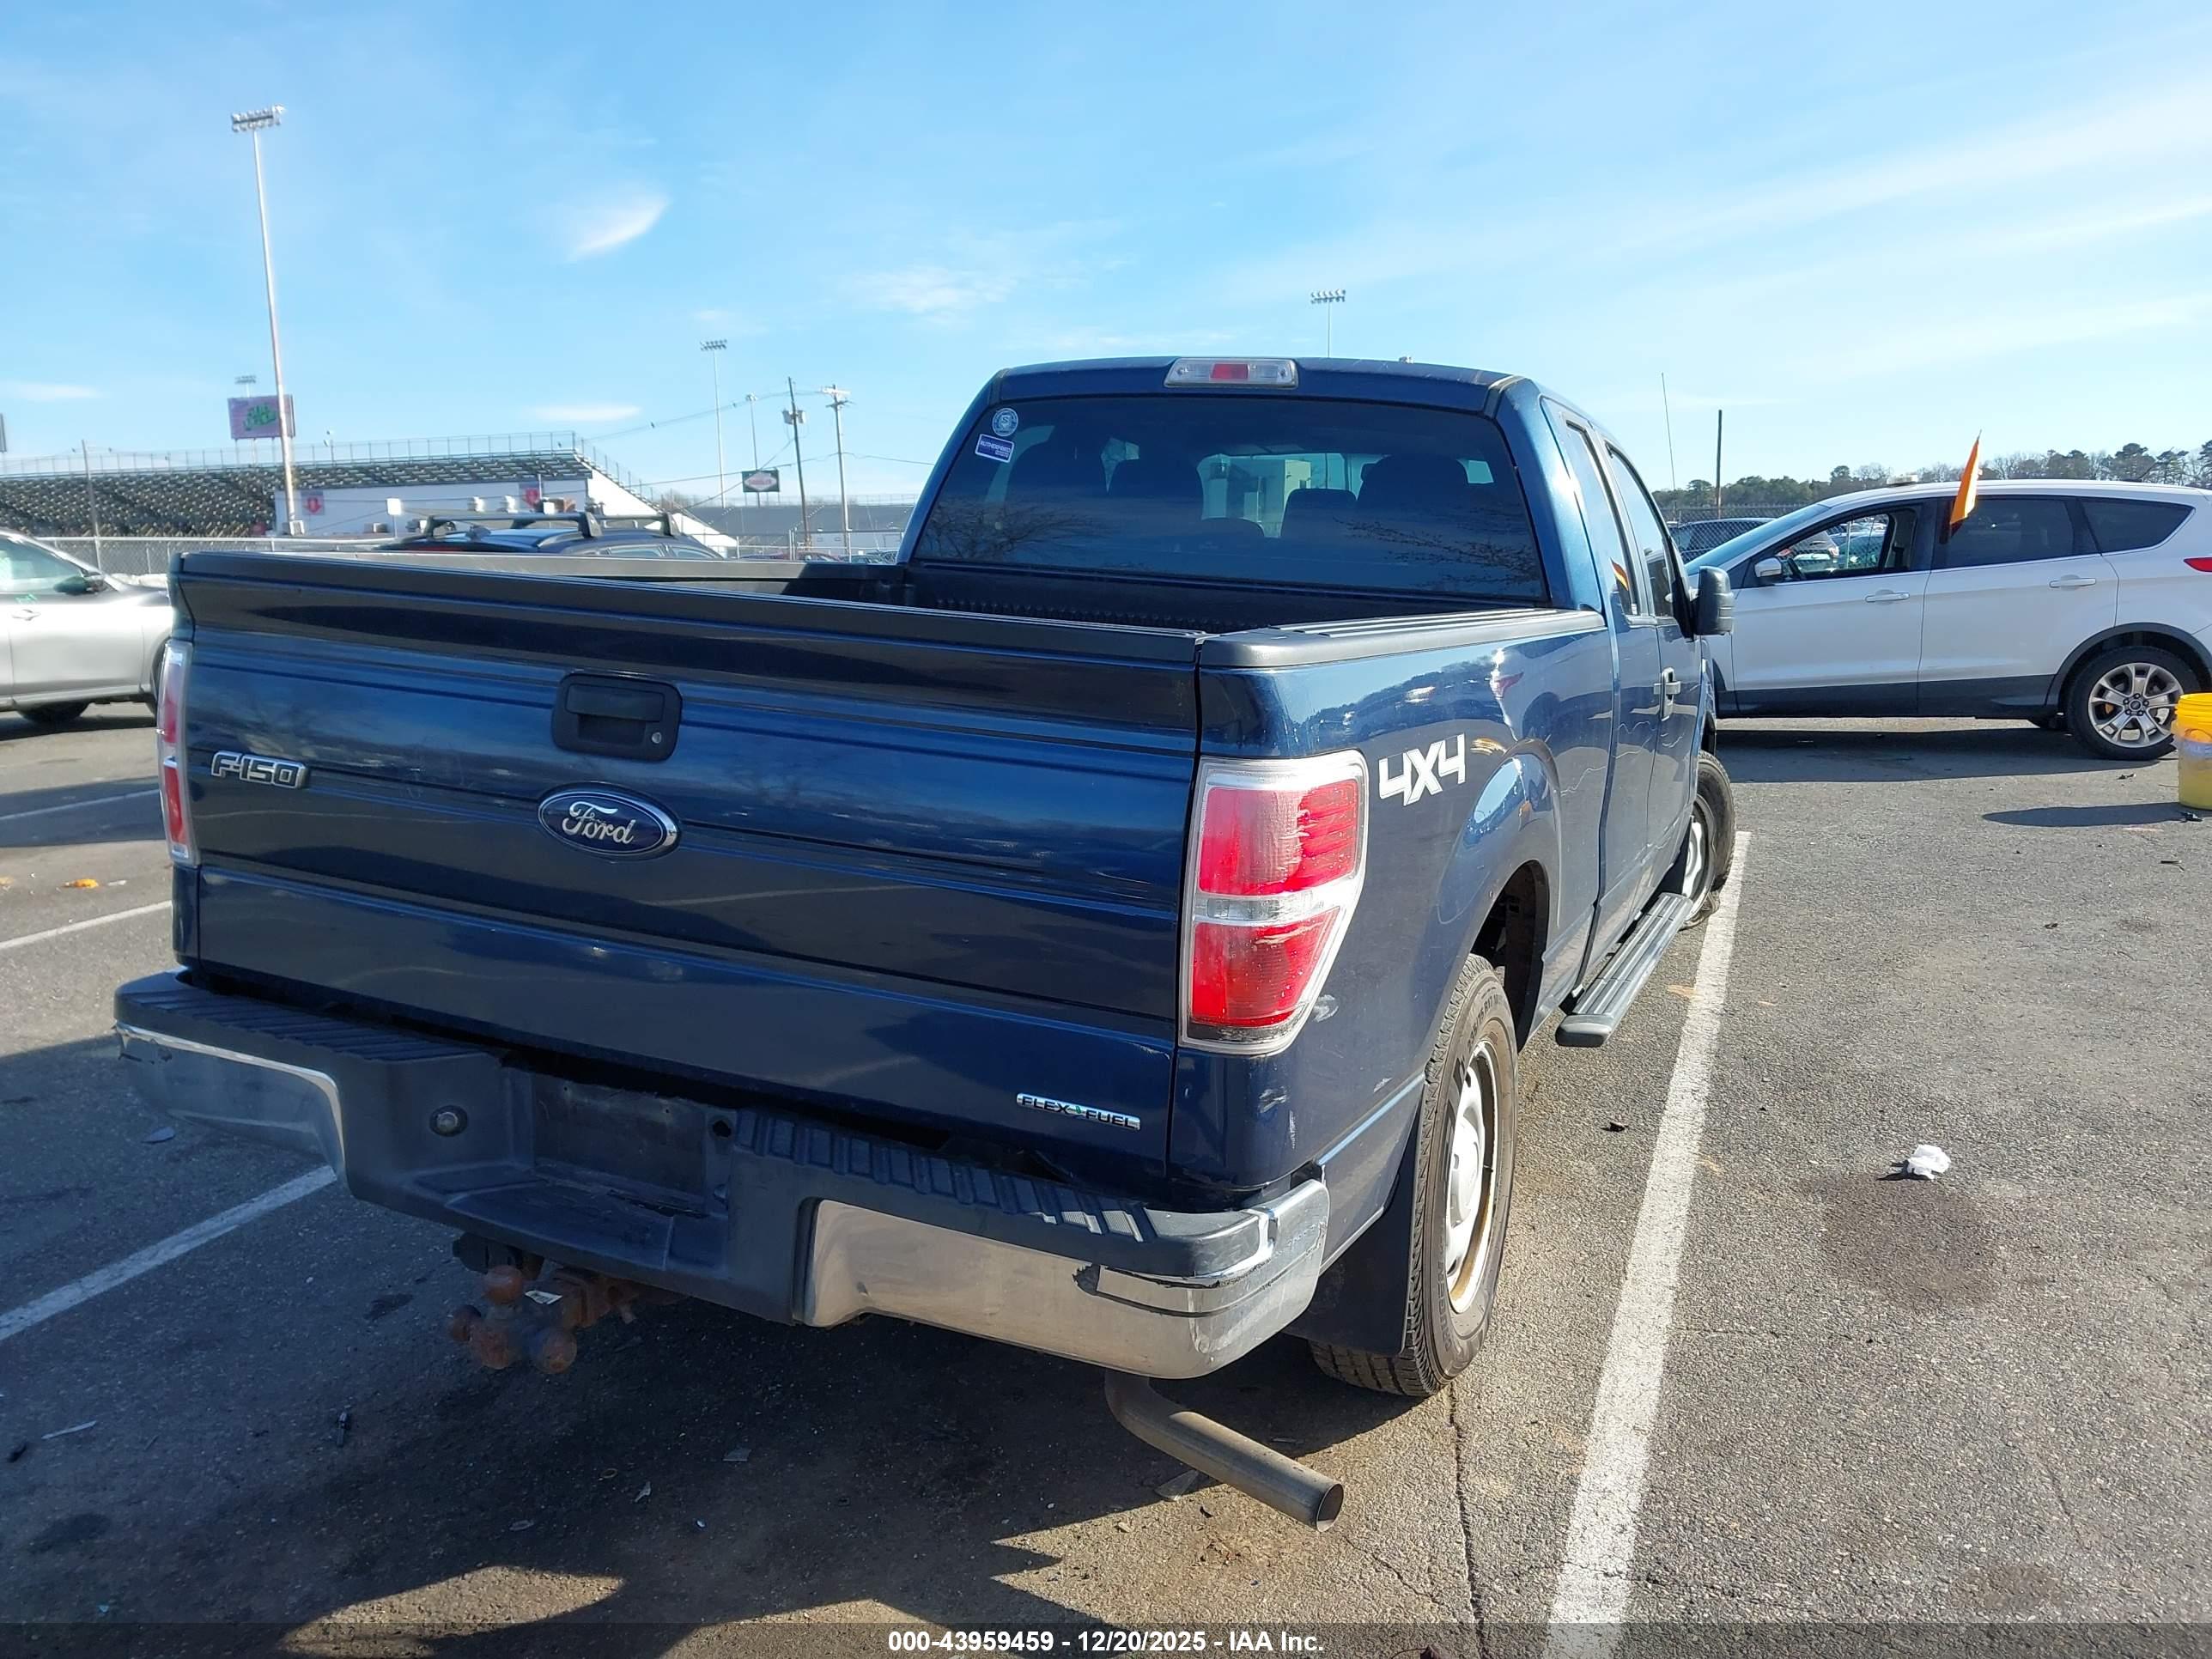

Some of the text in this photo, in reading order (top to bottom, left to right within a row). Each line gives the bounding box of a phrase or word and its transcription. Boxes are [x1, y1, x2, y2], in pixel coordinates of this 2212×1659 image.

[210, 750, 307, 790] F-150
[562, 800, 636, 845] Ford
[1021, 1096, 1139, 1130] FLEX FUEL
